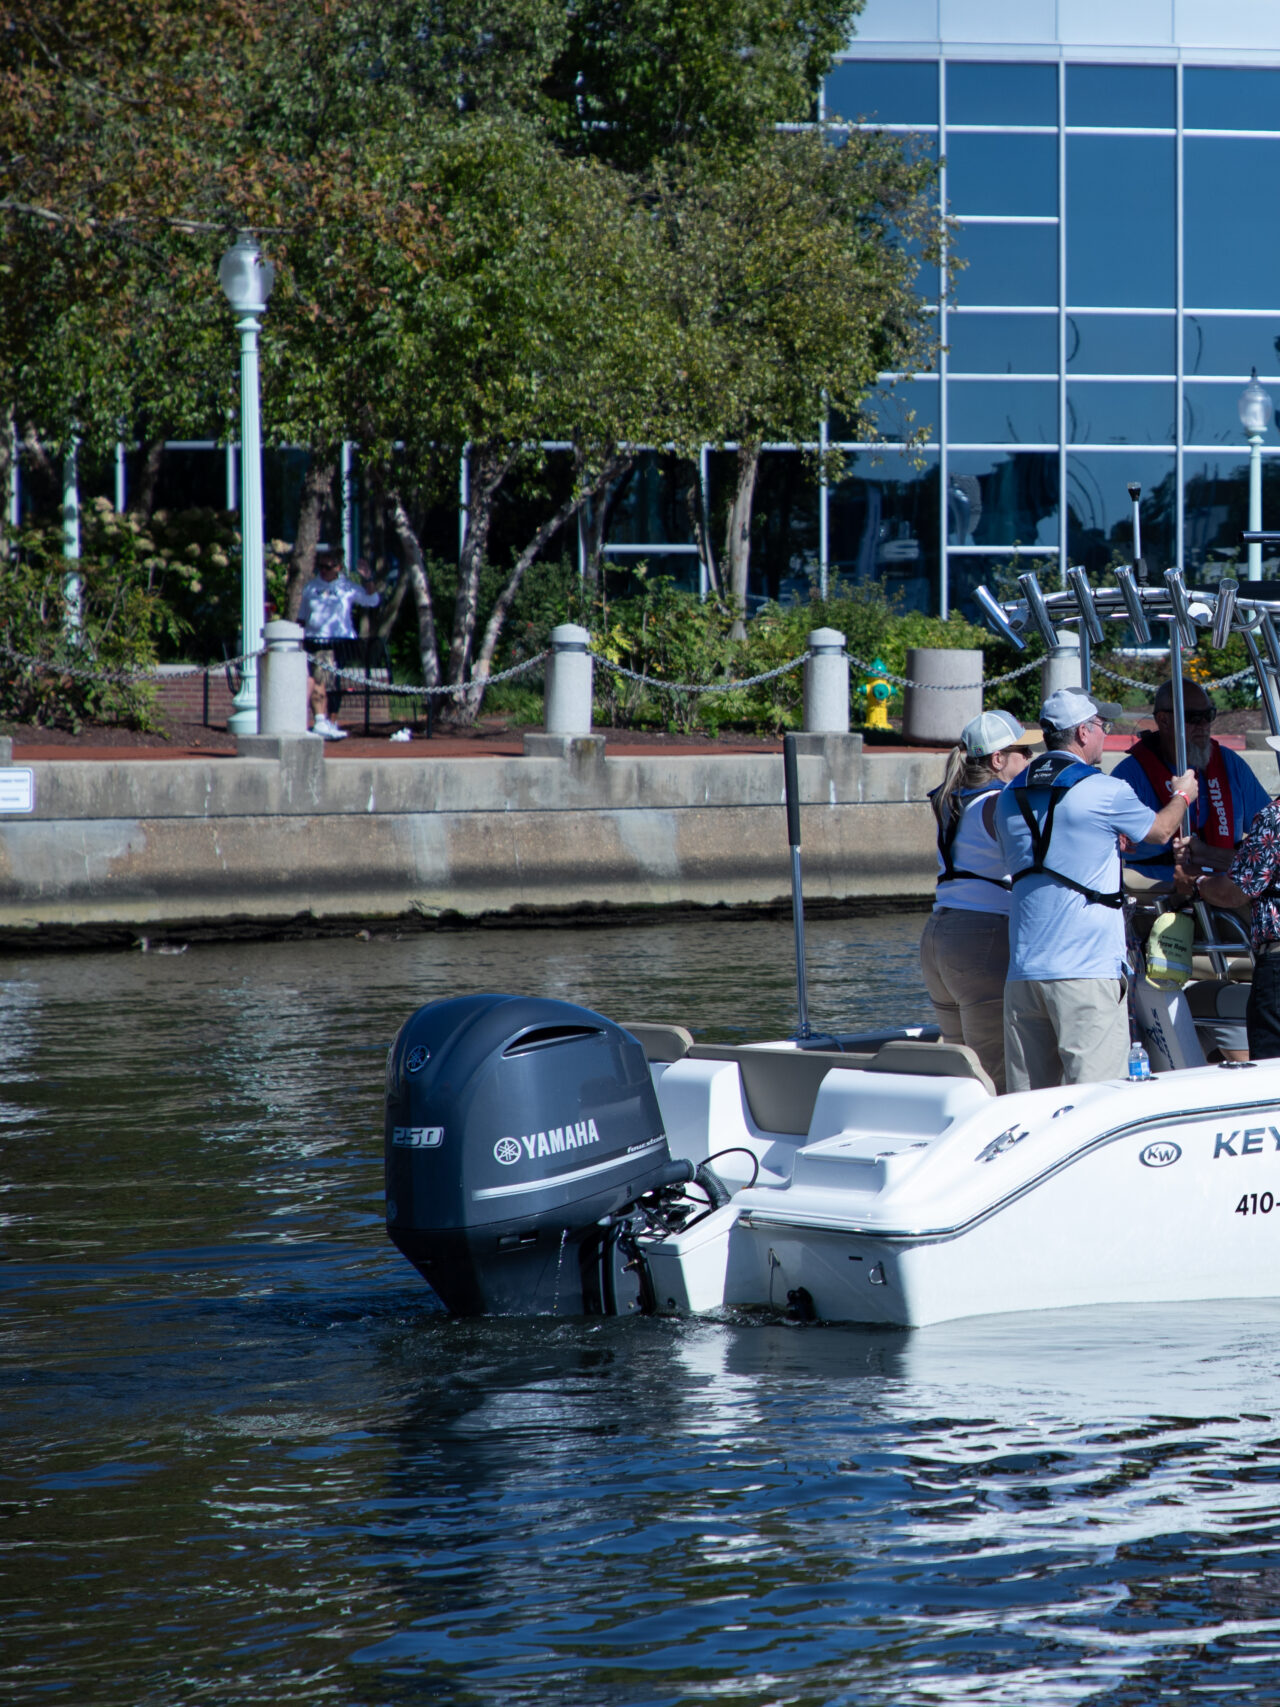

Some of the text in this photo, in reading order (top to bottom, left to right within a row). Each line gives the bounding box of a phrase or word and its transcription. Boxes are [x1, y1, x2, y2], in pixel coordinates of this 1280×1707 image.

[392, 1126, 443, 1147] 250
[521, 1118, 600, 1160] YAMAHA
[1144, 1144, 1177, 1164] KW
